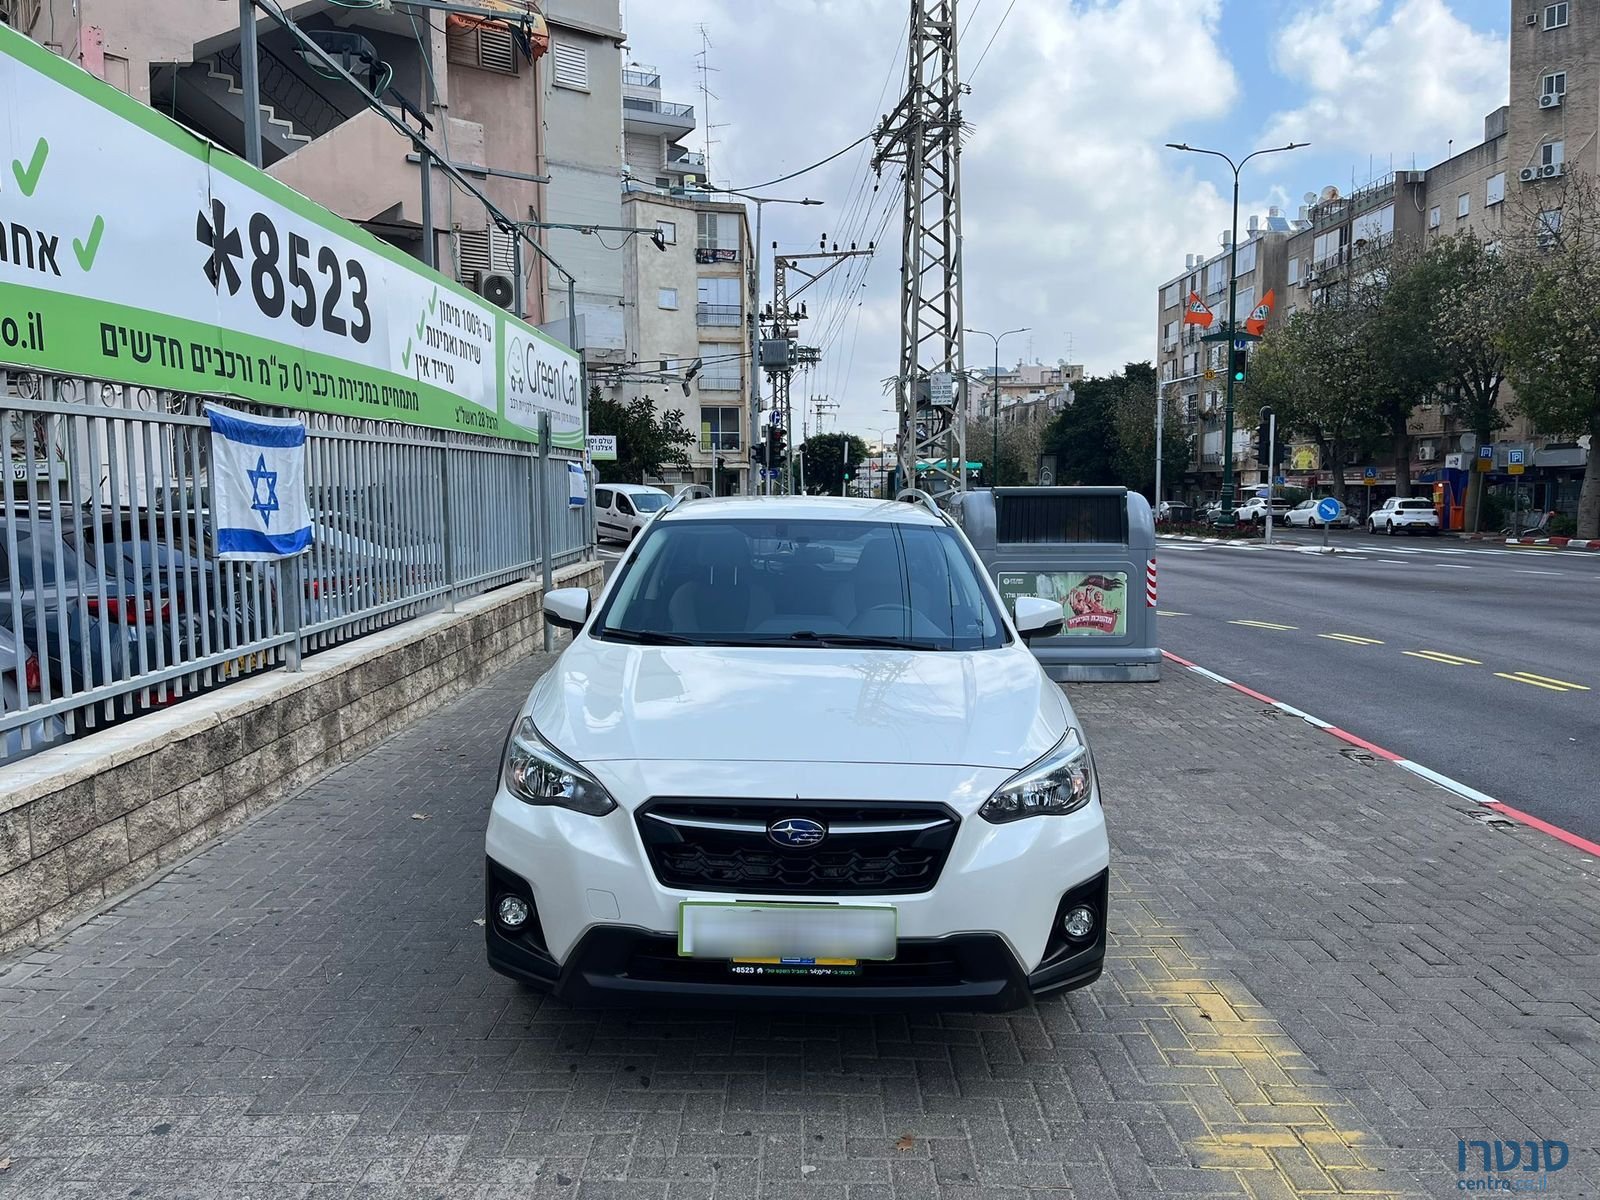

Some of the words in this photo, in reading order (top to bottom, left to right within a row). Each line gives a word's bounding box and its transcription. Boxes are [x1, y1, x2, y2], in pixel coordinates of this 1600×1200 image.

[440, 300, 460, 328] מימון
[462, 309, 482, 338] 100%
[100, 322, 184, 370] חדשים
[426, 324, 458, 356] ואמינות
[482, 322, 491, 343] עד
[190, 342, 253, 383] ורכבים
[460, 339, 481, 365] שירות
[293, 362, 303, 393] 0
[415, 353, 430, 382] אין
[431, 358, 454, 384] טרייד
[526, 342, 561, 400] Green
[561, 360, 578, 406] Car
[305, 370, 336, 398] רכבי
[338, 376, 380, 405] במכירת
[382, 385, 419, 412] מתמחים
[477, 411, 485, 428] 28
